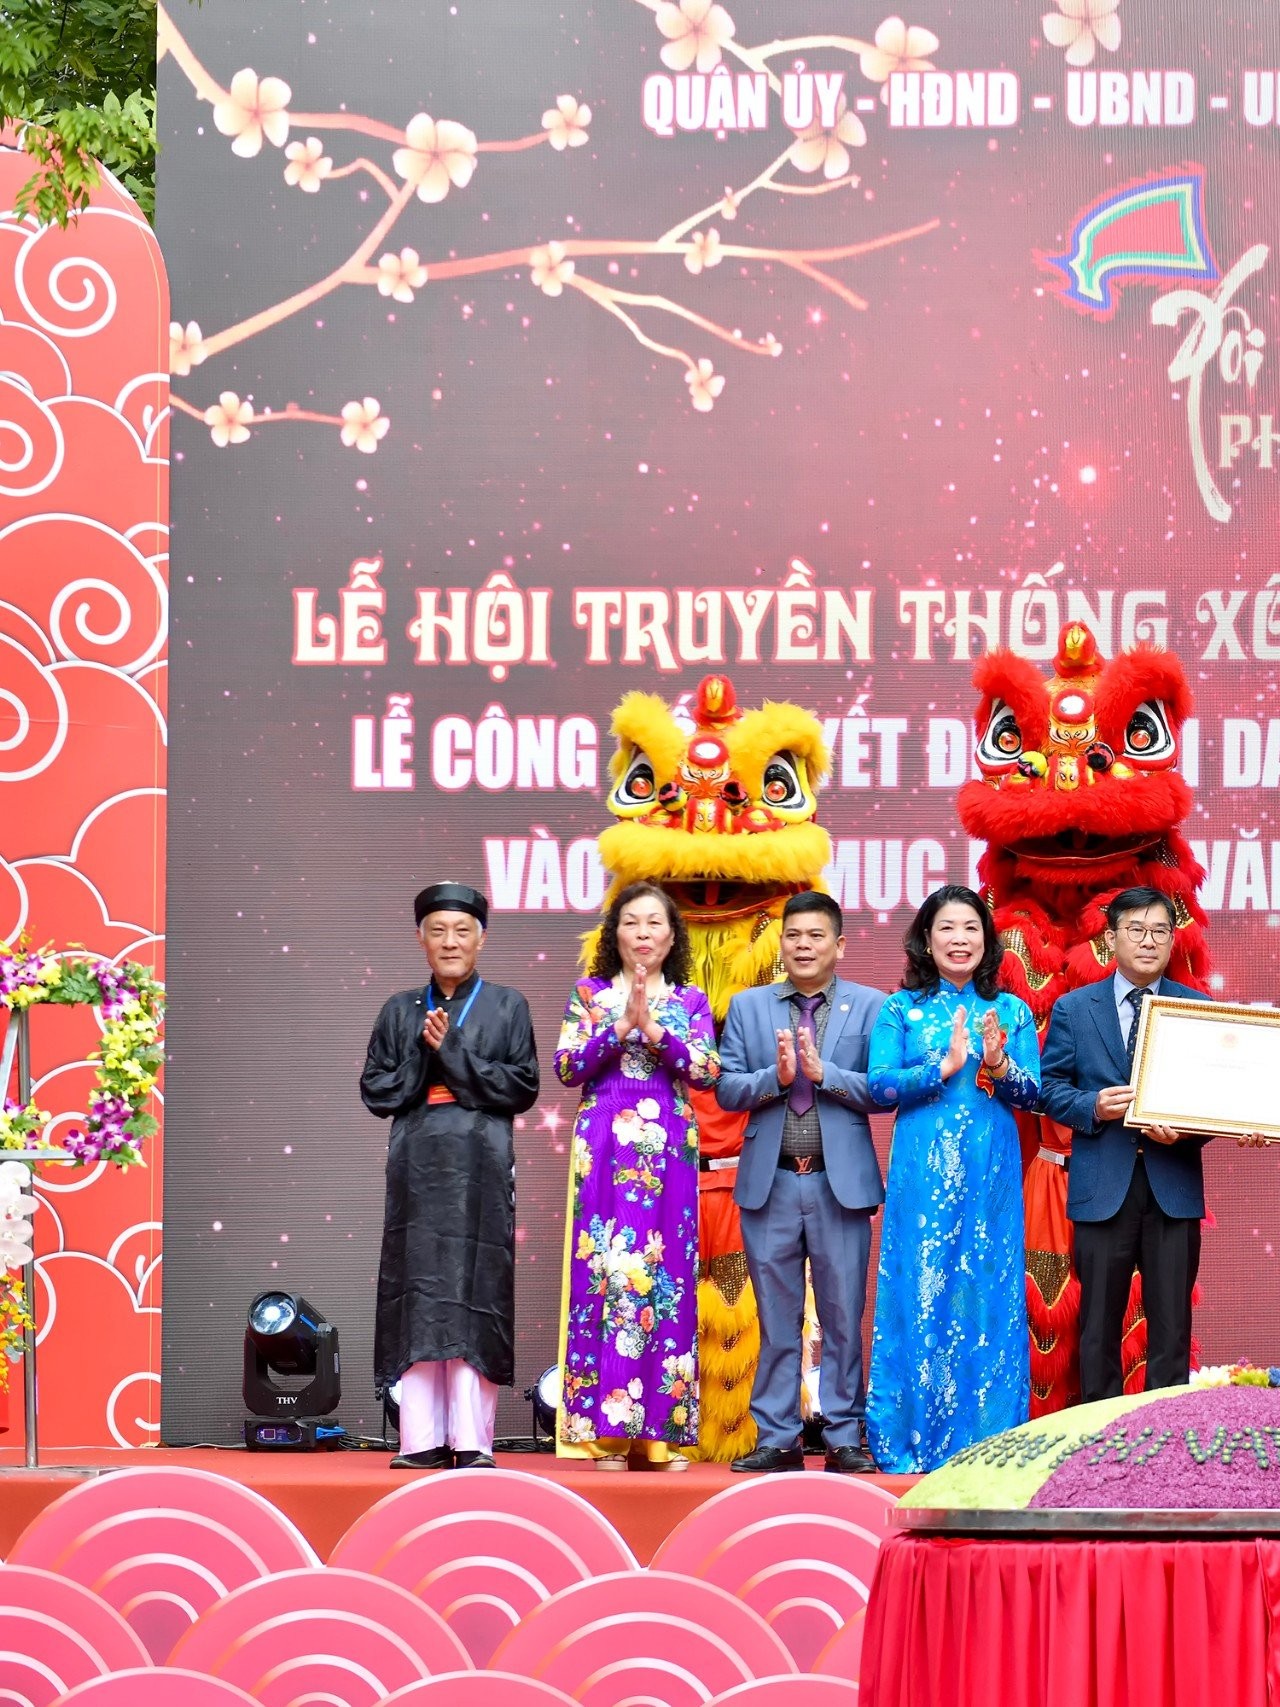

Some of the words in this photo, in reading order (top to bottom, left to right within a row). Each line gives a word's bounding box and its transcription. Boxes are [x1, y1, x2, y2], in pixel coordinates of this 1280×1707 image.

[643, 65, 767, 140] QUẬN
[782, 59, 844, 128] ỦY
[888, 71, 1018, 127] HĐND
[1065, 71, 1195, 127] UBND
[293, 557, 388, 663] LỄ
[407, 570, 553, 682] HỘI
[573, 557, 876, 671] TRUYỀN
[900, 561, 1168, 661] THỐNG
[352, 695, 415, 788] LỄ
[431, 706, 599, 789] CÔNG
[484, 828, 606, 911] VÀO
[820, 838, 947, 924] MỤC
[276, 1396, 298, 1405] THV
